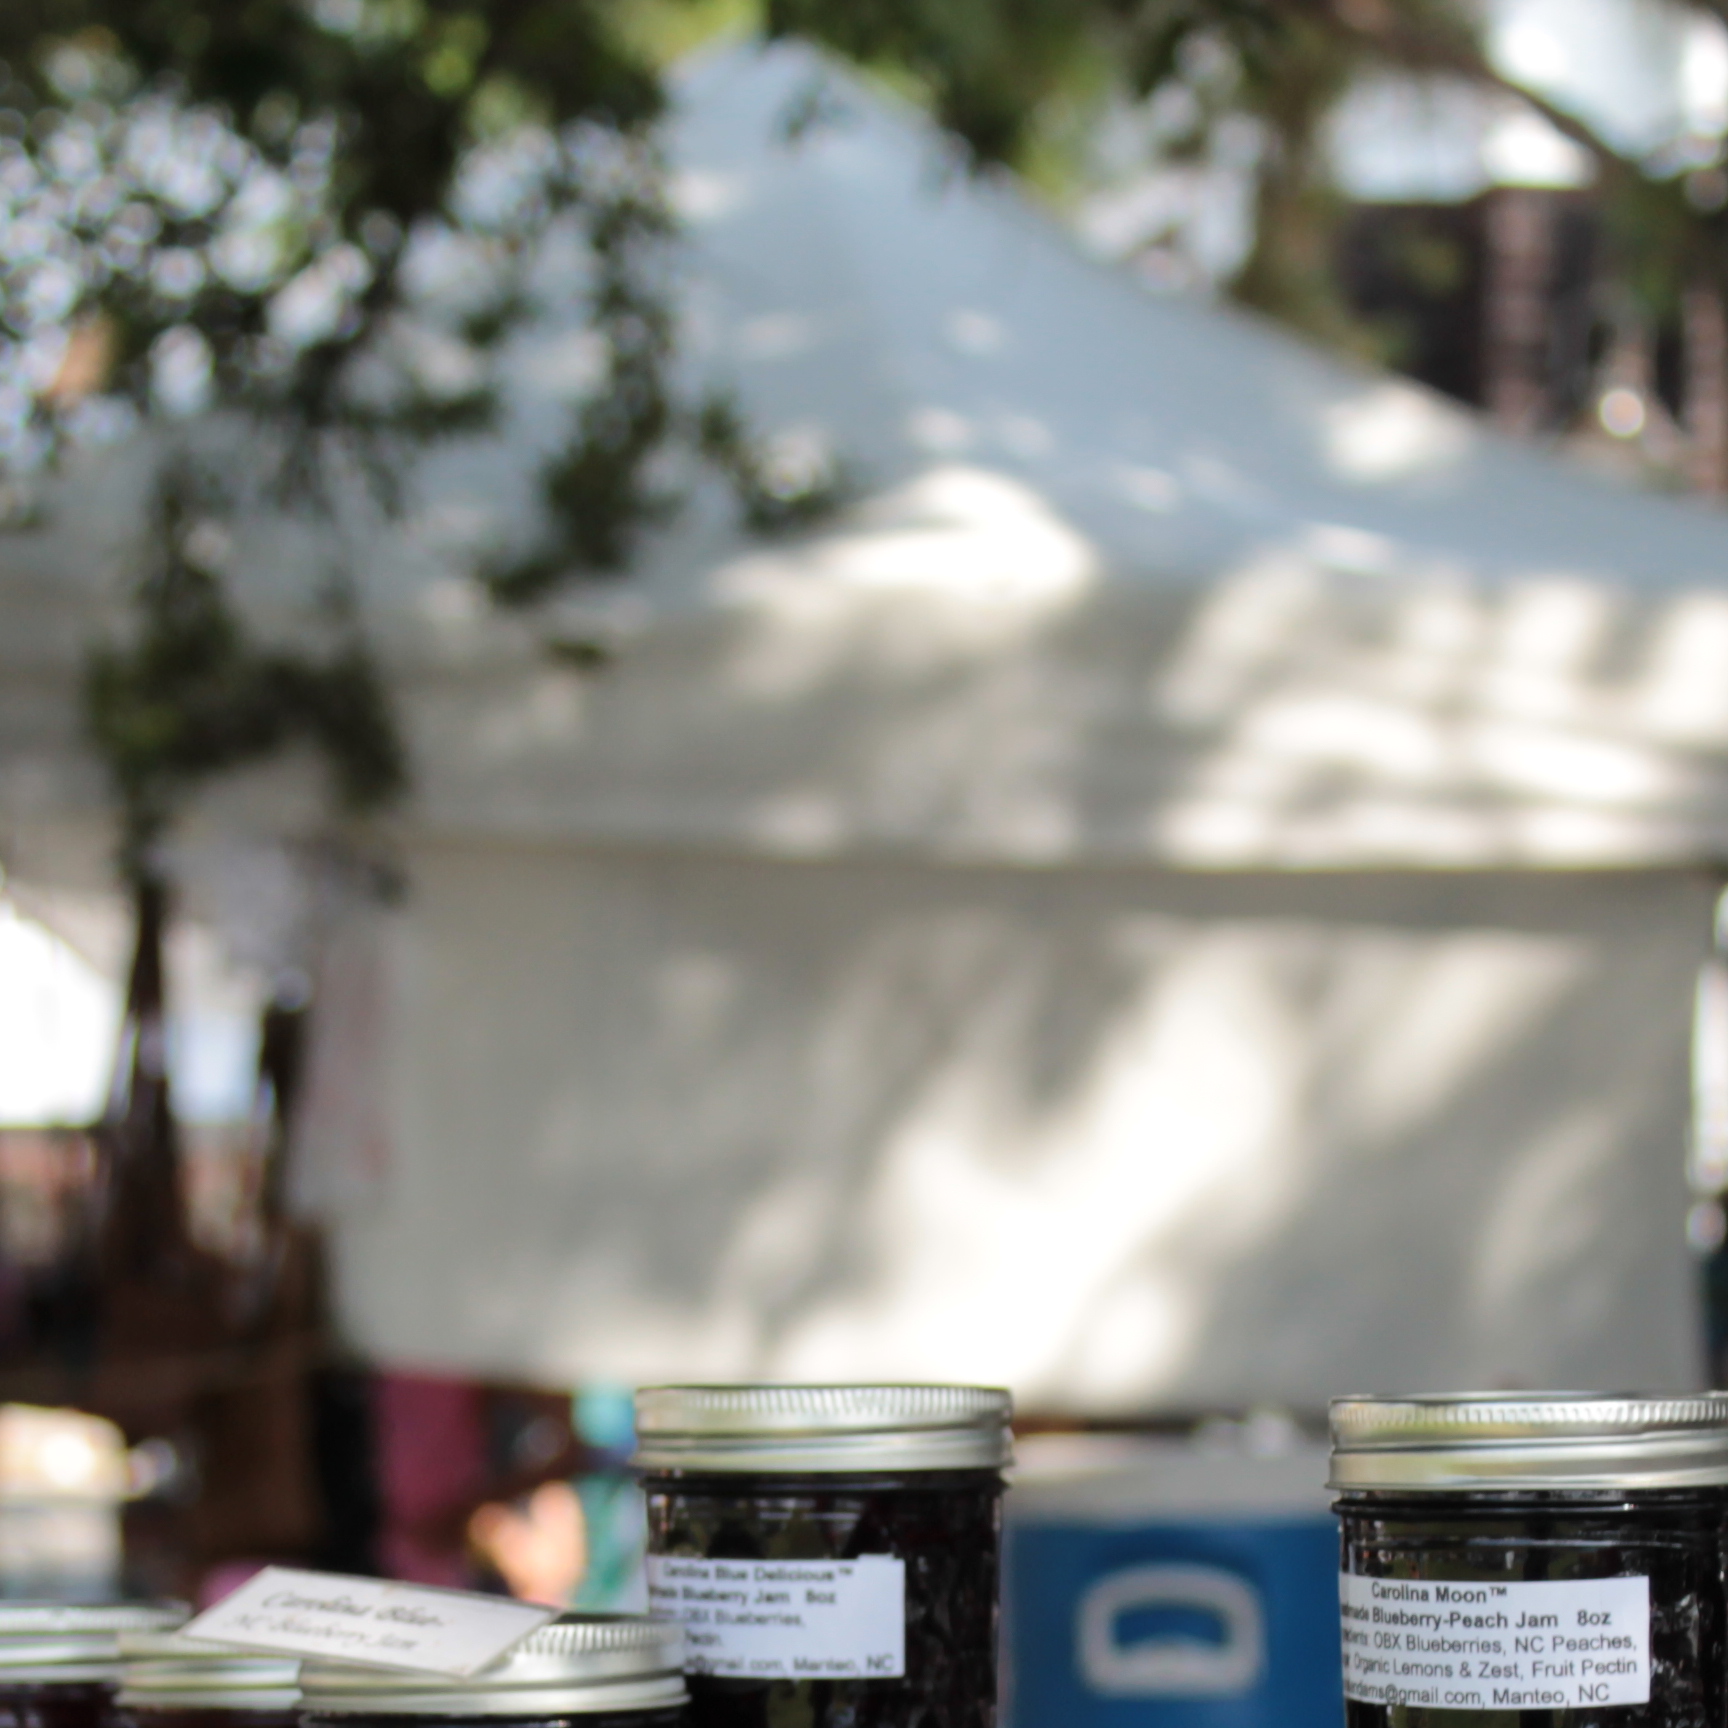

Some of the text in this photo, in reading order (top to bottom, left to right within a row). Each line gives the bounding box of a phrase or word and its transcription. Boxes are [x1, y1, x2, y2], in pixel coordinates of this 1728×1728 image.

[714, 1565, 747, 1580] Blue
[754, 1589, 790, 1604] Jam
[1371, 1582, 1429, 1602] Carolina
[1372, 1608, 1611, 1631] Blueberry-Peach Jam 8oz
[1374, 1633, 1637, 1655] OBX Blueberries, NC Peaches,
[867, 1656, 893, 1671] NC
[1393, 1658, 1453, 1678] Lemons
[1460, 1661, 1472, 1677] &
[1479, 1661, 1524, 1680] Zest,
[1533, 1661, 1574, 1677] Fruit
[1581, 1658, 1637, 1675] Pectin
[1493, 1685, 1610, 1707] Manteo, NC
